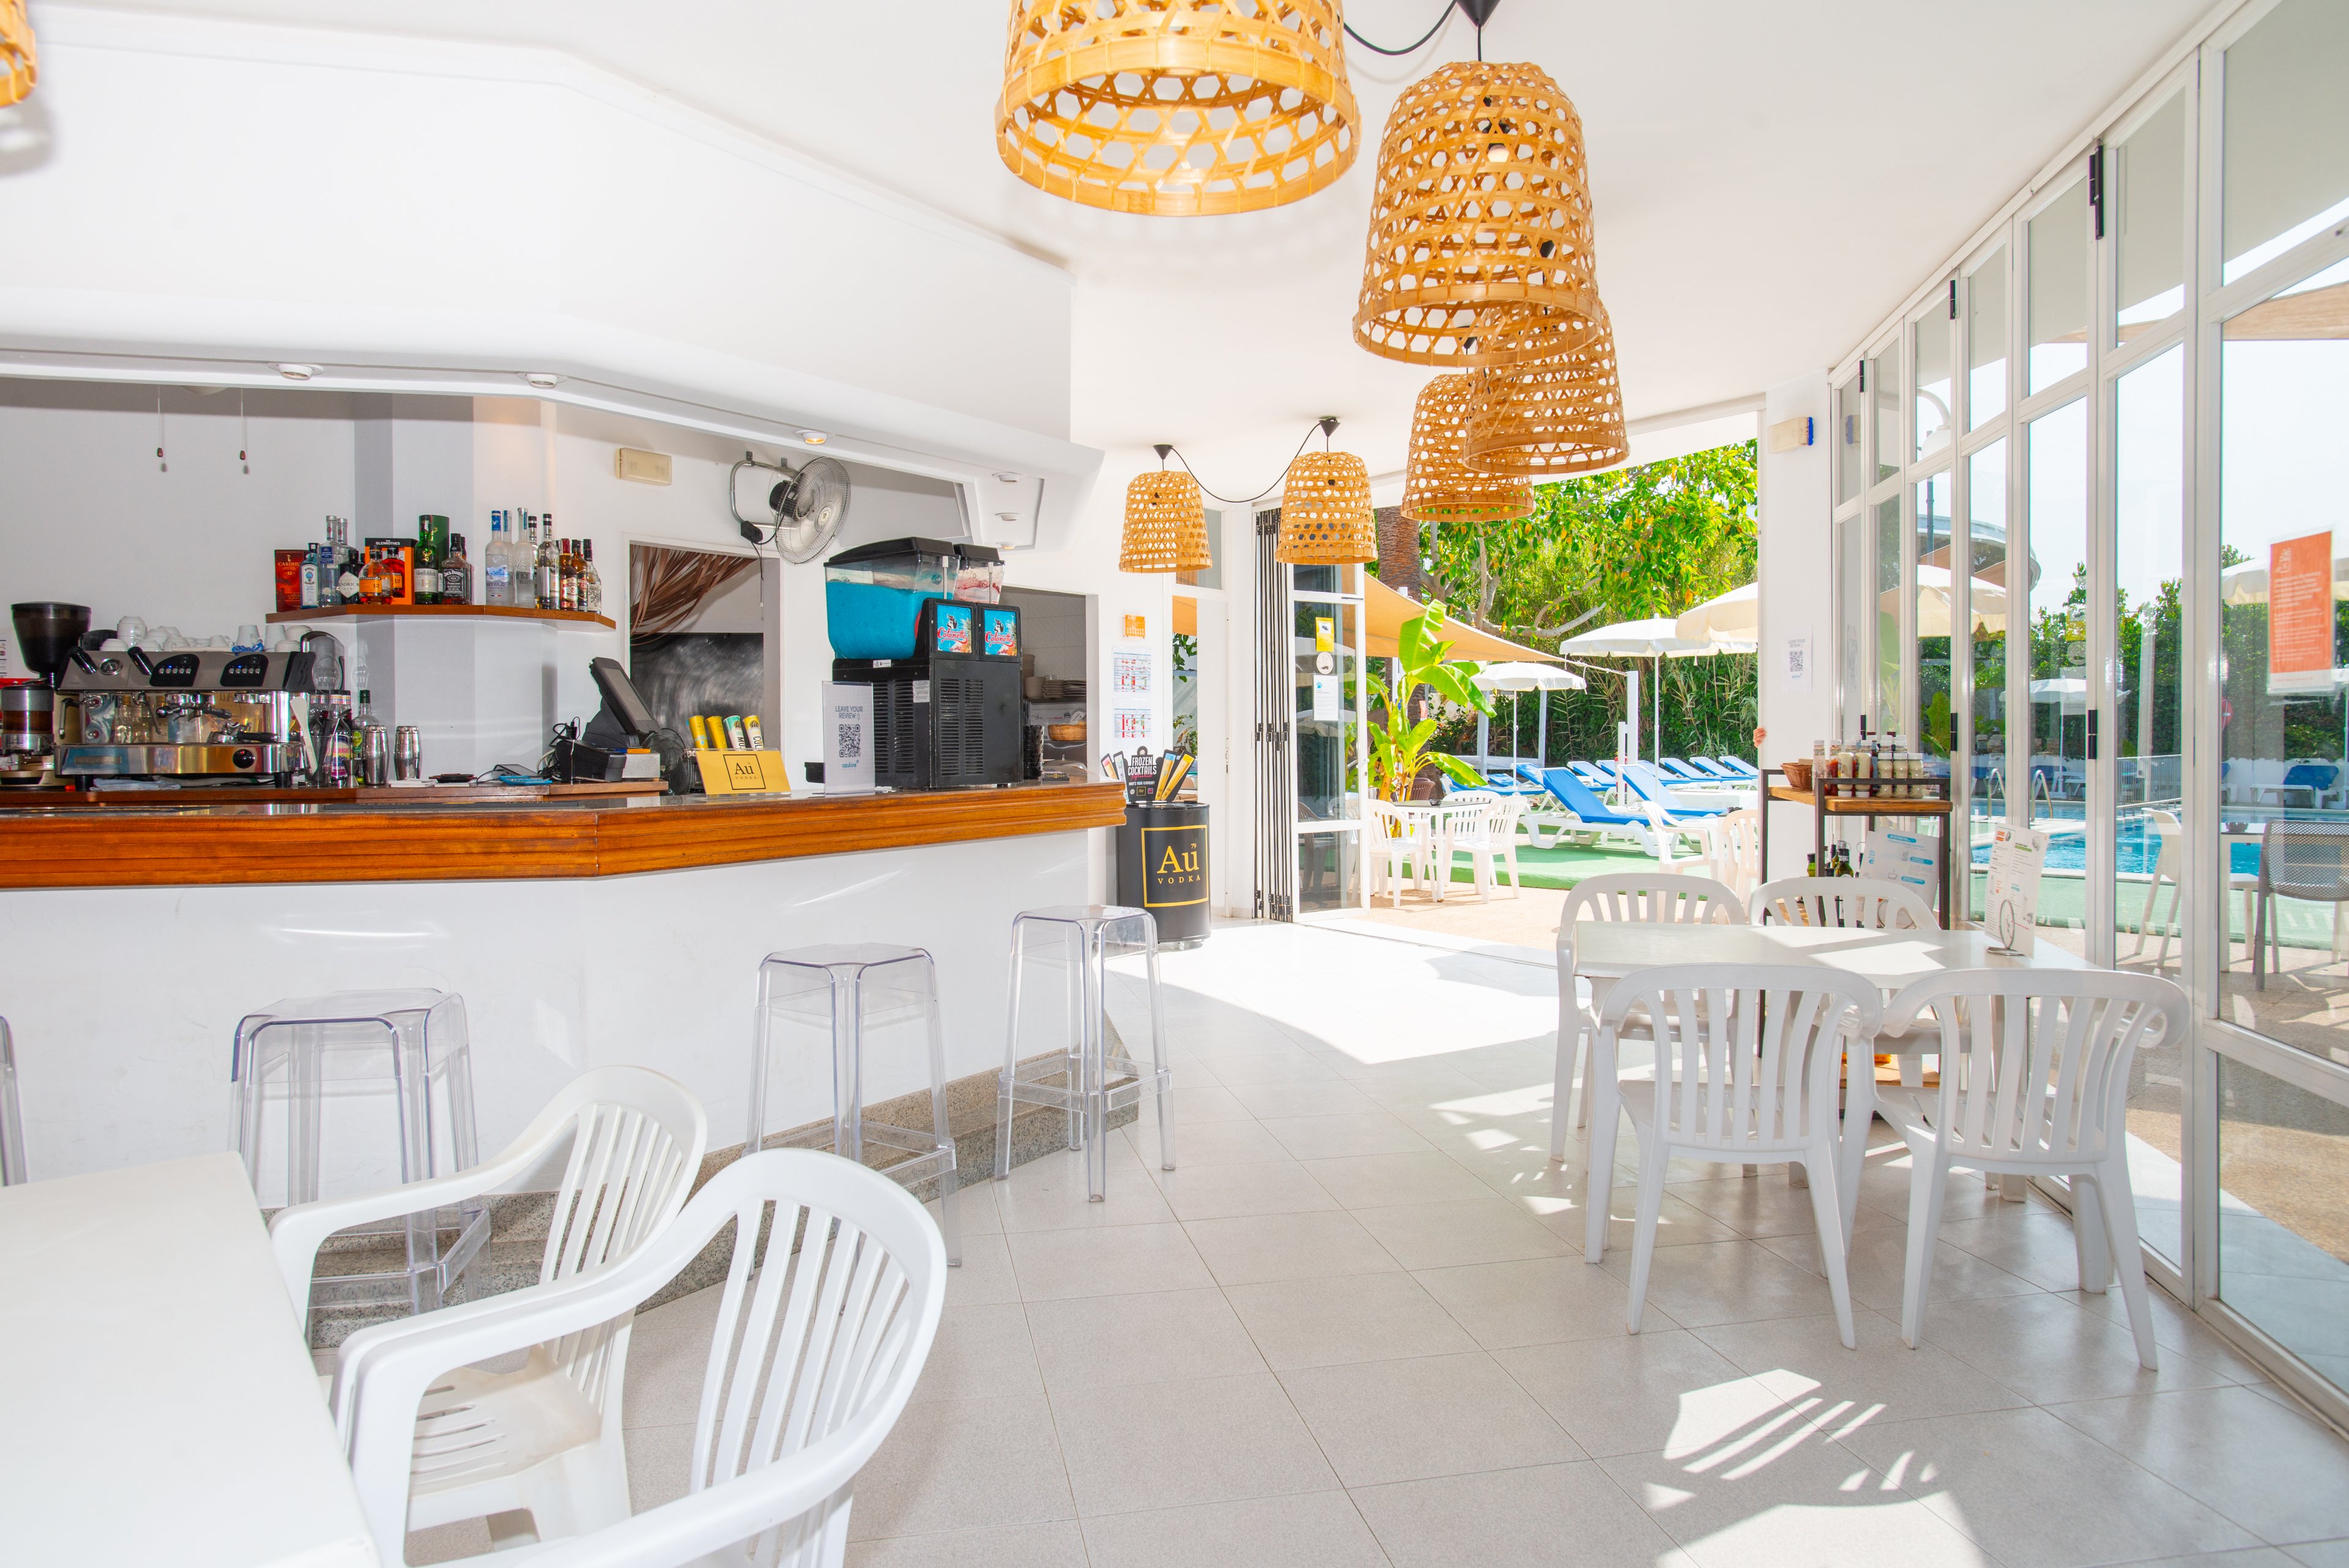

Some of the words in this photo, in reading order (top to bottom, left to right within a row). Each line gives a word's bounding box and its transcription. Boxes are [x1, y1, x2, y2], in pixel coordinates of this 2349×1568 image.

[937, 627, 967, 642] Colonette
[984, 631, 1014, 645] Colonette
[737, 737, 746, 748] MO
[753, 736, 763, 748] COL
[1132, 757, 1152, 766] FROZEN
[735, 762, 755, 775] Au
[1127, 765, 1157, 776] COCKTAILS
[1157, 845, 1199, 874] Au
[1157, 874, 1200, 885] VODKA
